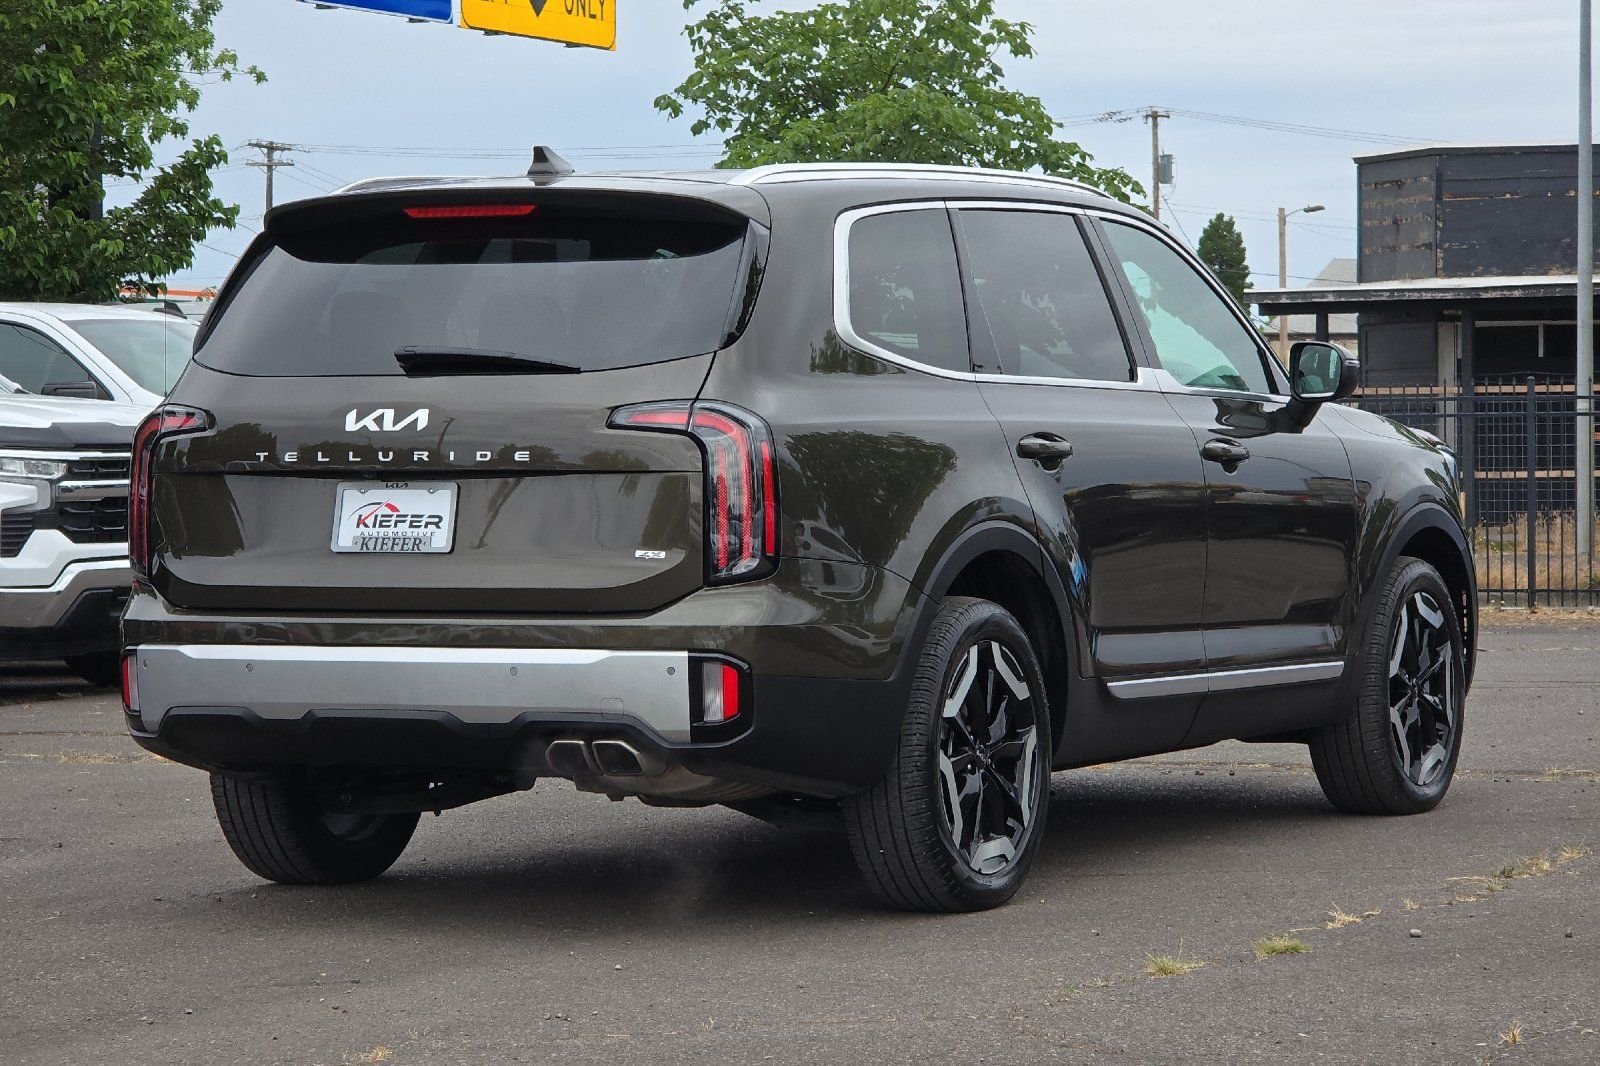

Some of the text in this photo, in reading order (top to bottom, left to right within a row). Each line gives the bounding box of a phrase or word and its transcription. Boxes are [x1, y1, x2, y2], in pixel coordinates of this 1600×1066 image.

[345, 409, 429, 432] KIA
[256, 451, 531, 463] TELLURIDE
[355, 513, 443, 529] KIEFER
[359, 537, 423, 552] KIEFER
